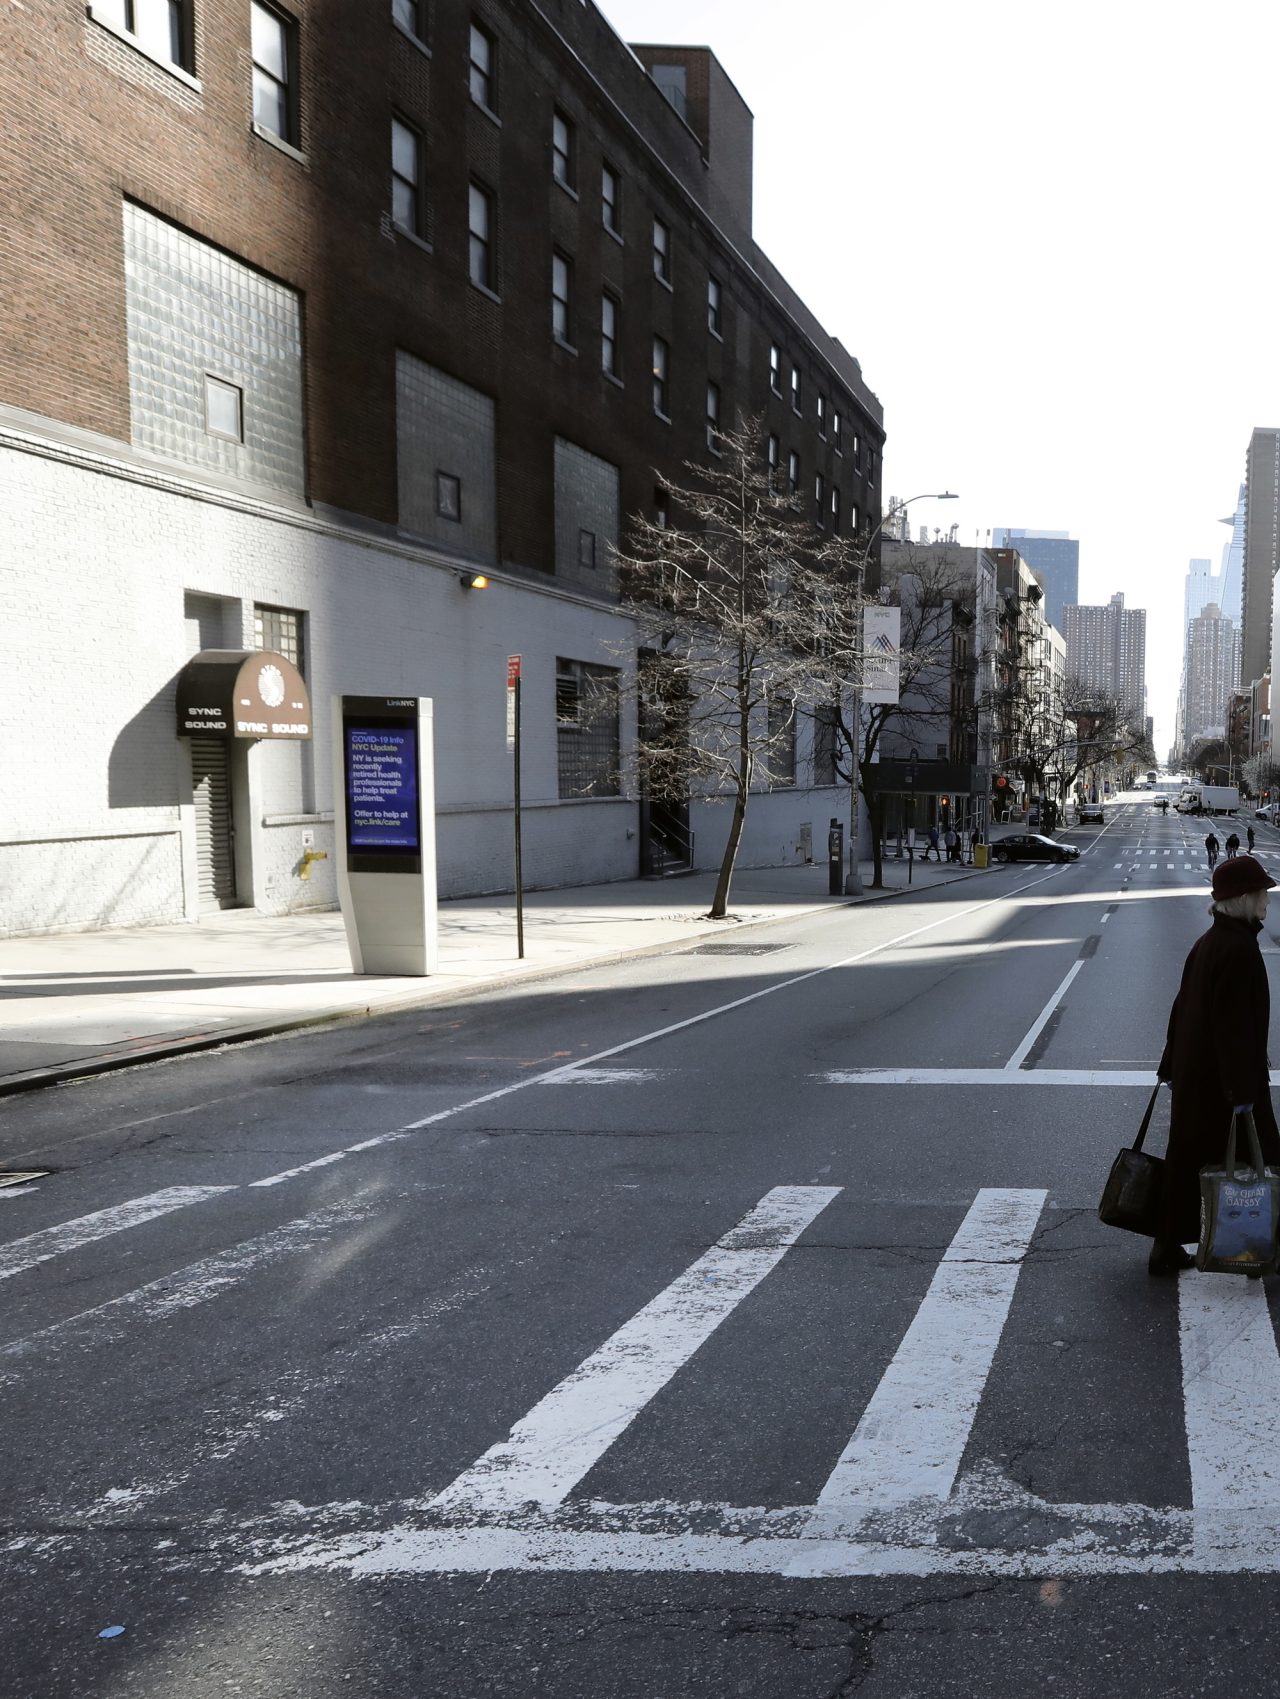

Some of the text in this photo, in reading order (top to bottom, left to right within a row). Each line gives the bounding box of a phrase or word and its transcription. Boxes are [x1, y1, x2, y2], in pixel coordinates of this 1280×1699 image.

[386, 699, 415, 707] LinkNYC
[188, 707, 222, 716] SYNC
[185, 721, 227, 729] SOUND
[237, 721, 309, 734] SYNC SOUND
[351, 735, 404, 744] COVID-19 Info
[351, 743, 398, 752] NYC Update
[352, 754, 364, 762] NY
[373, 755, 402, 764] seeking
[352, 763, 382, 771] recently
[377, 771, 401, 779] health
[353, 779, 402, 787] professionals
[362, 787, 379, 795] help
[380, 787, 397, 795] treat
[383, 811, 399, 819] help
[354, 818, 401, 826] nyc.link/care
[1226, 1196, 1261, 1207] GATSBY
